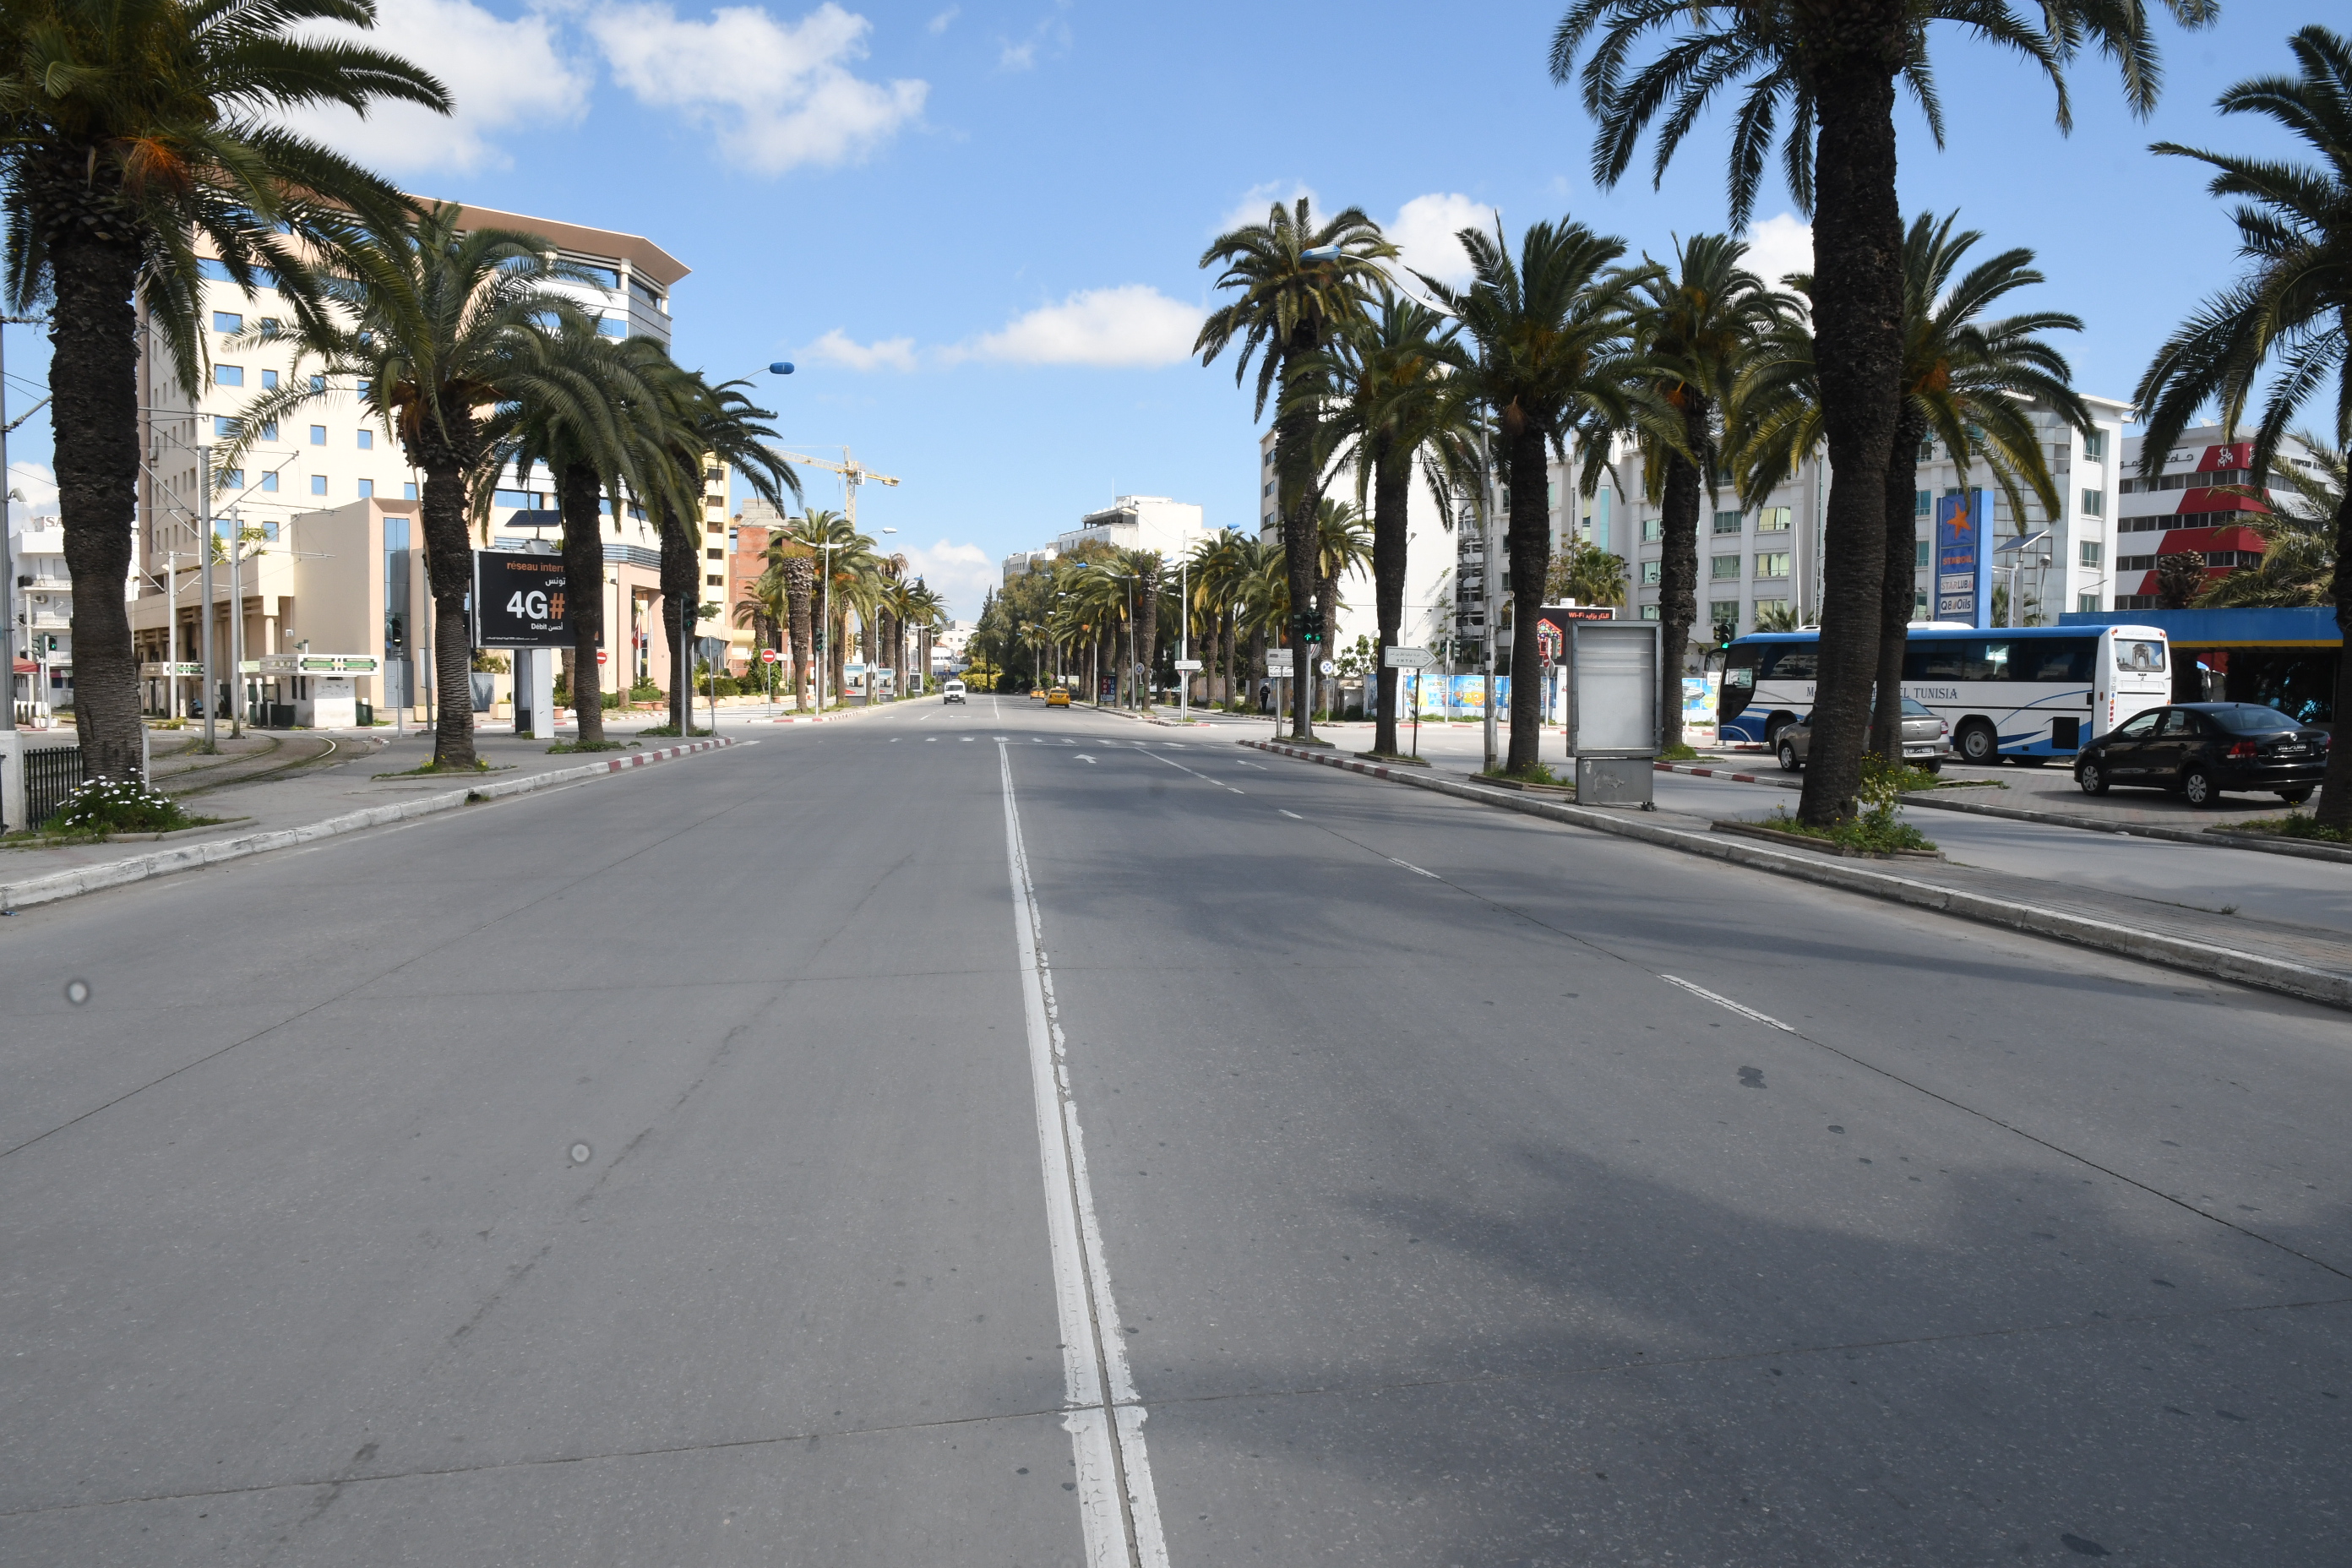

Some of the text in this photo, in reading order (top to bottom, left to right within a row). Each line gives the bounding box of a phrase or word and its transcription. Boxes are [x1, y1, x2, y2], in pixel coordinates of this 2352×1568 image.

[1942, 555, 1973, 564] STAROIL
[507, 561, 538, 571] réseau
[1913, 687, 1958, 700] TUNISIA
